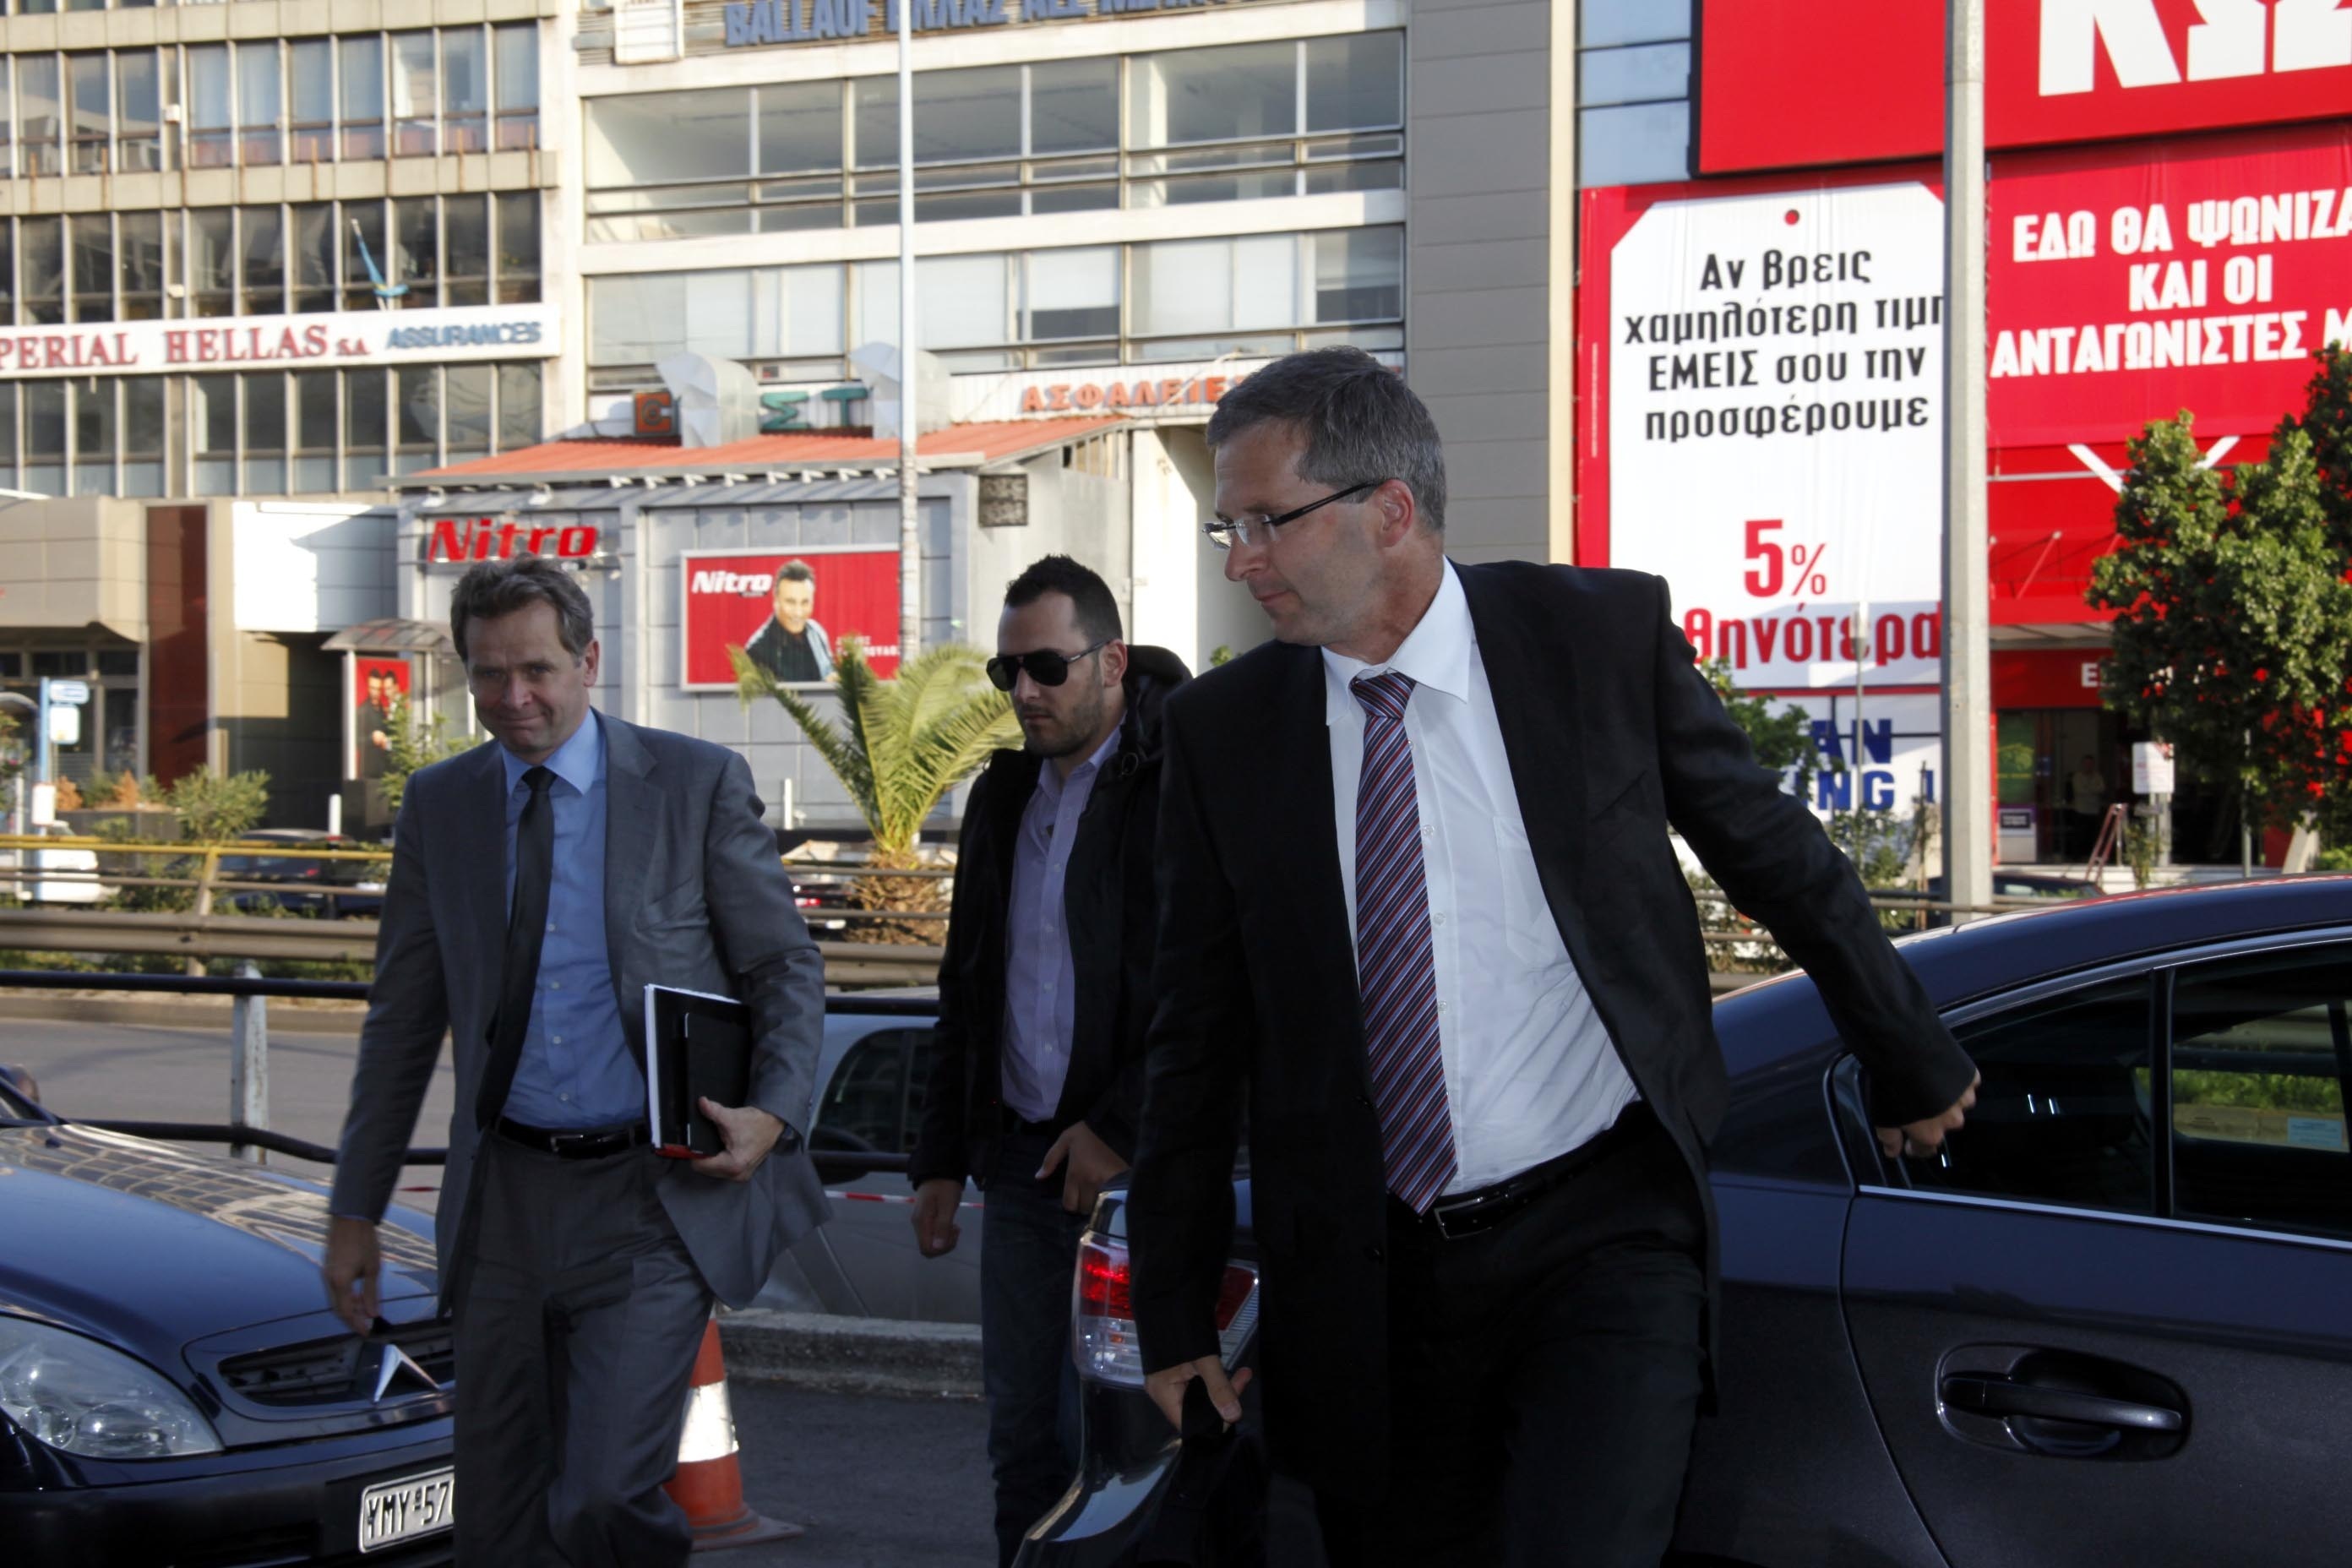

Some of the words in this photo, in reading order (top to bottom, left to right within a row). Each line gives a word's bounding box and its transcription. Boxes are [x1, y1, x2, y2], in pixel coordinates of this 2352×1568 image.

[2012, 210, 2097, 263] ΕΔΩ
[2110, 204, 2174, 255] ΘΑ
[1700, 253, 1745, 291] Αν
[1762, 249, 1871, 291] βρεις
[2128, 259, 2208, 312] ΚΑΙ
[2224, 253, 2273, 305] ΟΙ
[163, 324, 329, 363] HELLAS
[385, 321, 542, 350] ASSURANCES
[1624, 297, 1858, 345] χαμηλότερη
[1989, 310, 2308, 378] ΑΝΤΑΓΩΝΙΣΤΕΣ
[1022, 374, 1246, 412] ΑΣΦΑΛΕΙΕ
[1648, 350, 1759, 392] ΕΜΕΙΣ
[1776, 351, 1848, 384] σου
[1865, 347, 1926, 382] την
[1645, 394, 1929, 444] προσφέρουμε
[427, 518, 596, 564] Nitro
[1744, 518, 1827, 598] 5%
[691, 569, 773, 595] Nitro
[1683, 602, 1941, 670] θηνότερα
